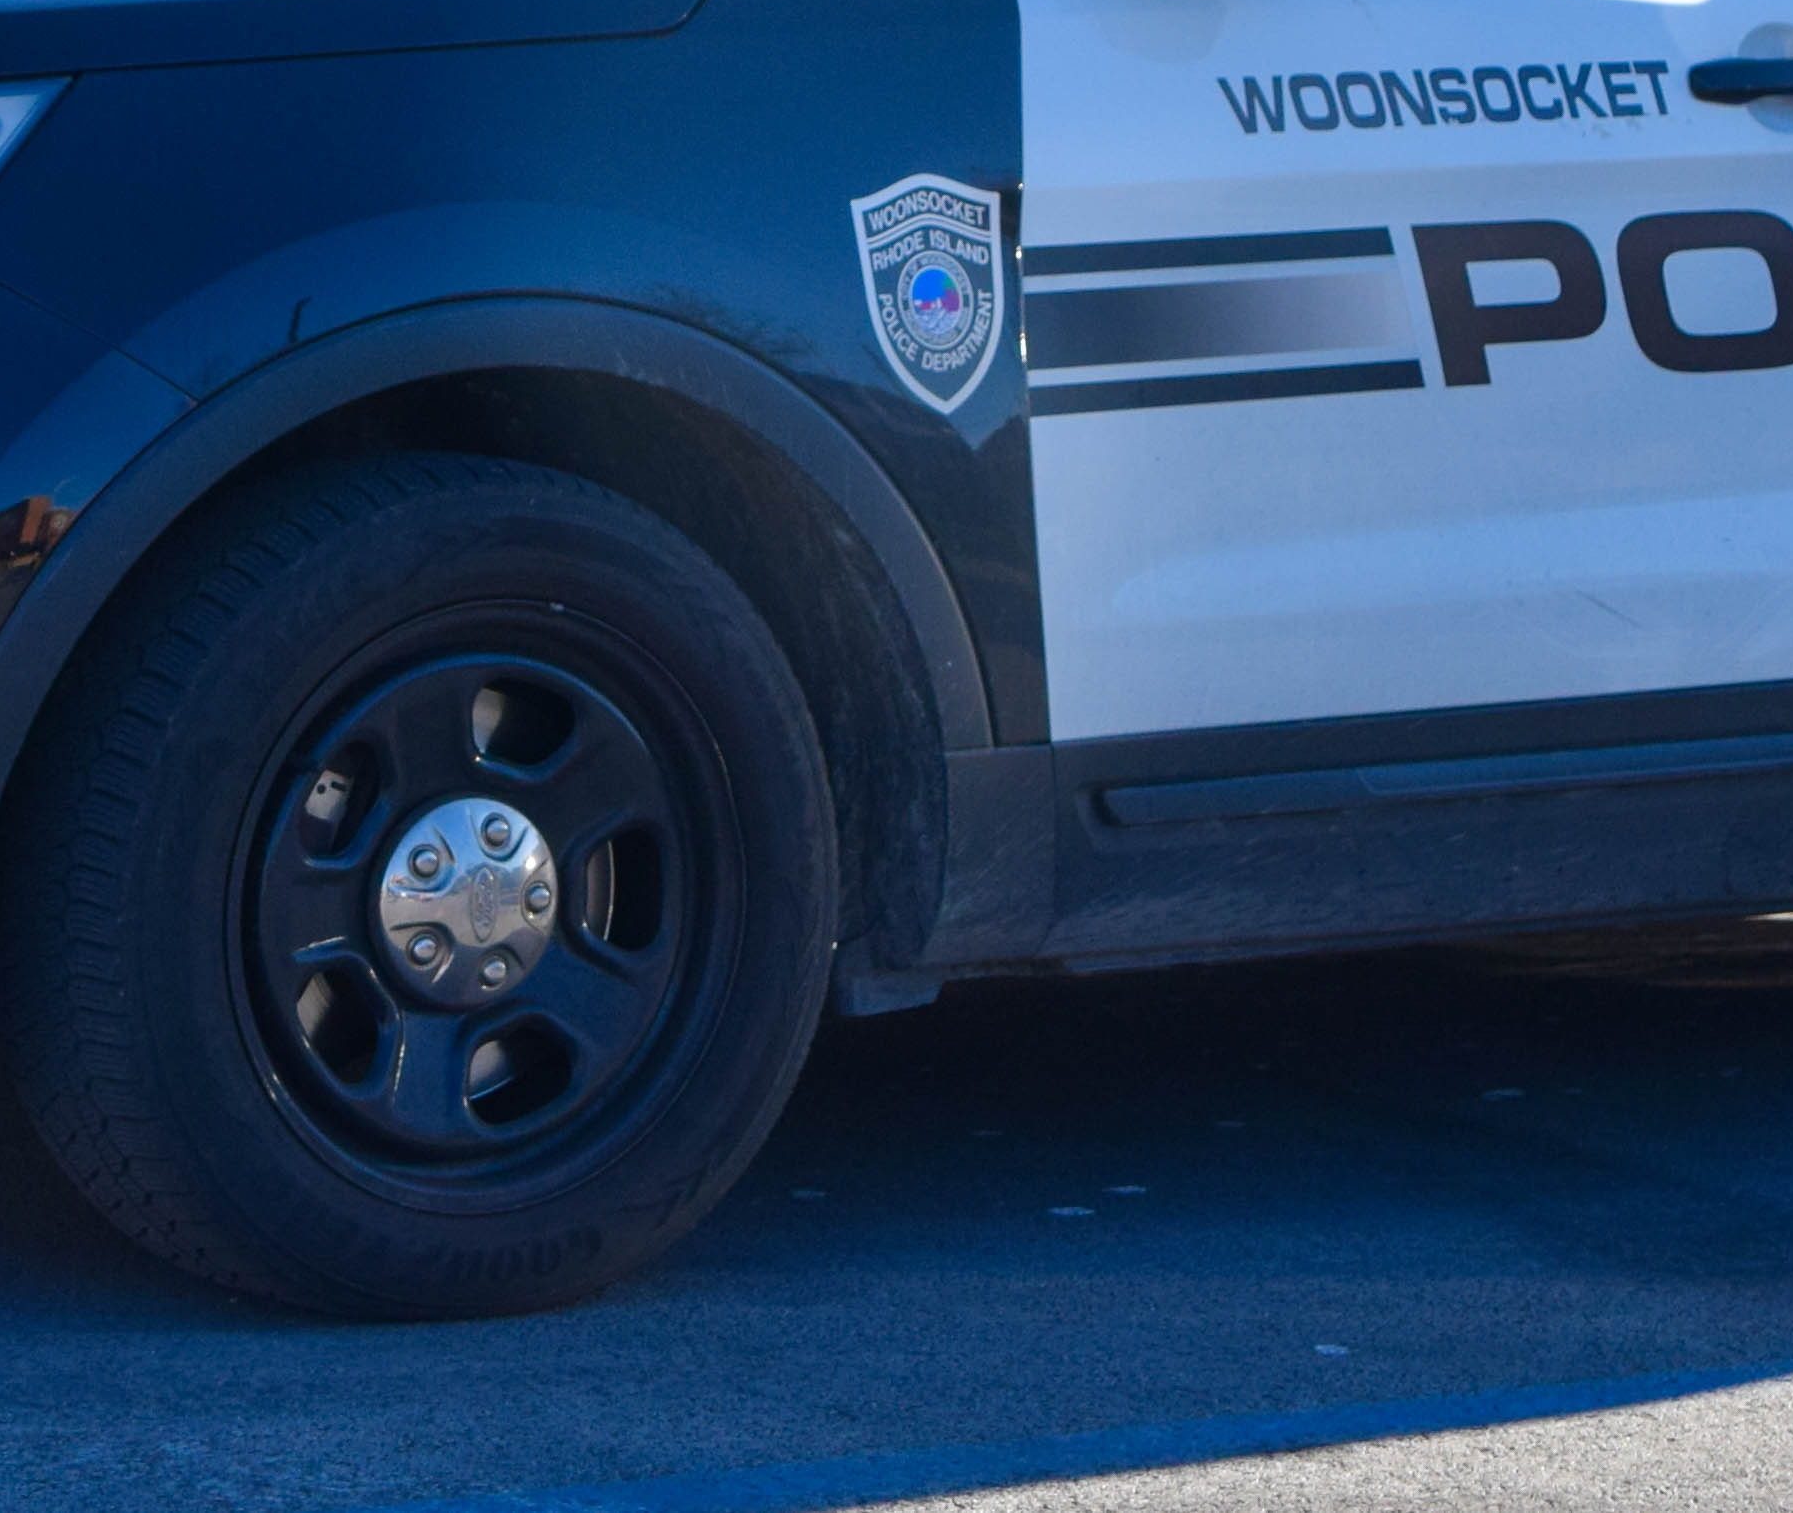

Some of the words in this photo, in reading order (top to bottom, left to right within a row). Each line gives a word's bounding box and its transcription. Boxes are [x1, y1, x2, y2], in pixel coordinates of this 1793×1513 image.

[1217, 60, 1669, 134] WOONSOCKET
[867, 190, 987, 232] WOONSOCKET
[872, 230, 925, 271] RHODE
[929, 229, 990, 265] ISLAND
[878, 293, 918, 361] POLICE
[921, 290, 994, 373] DEPARTMENT
